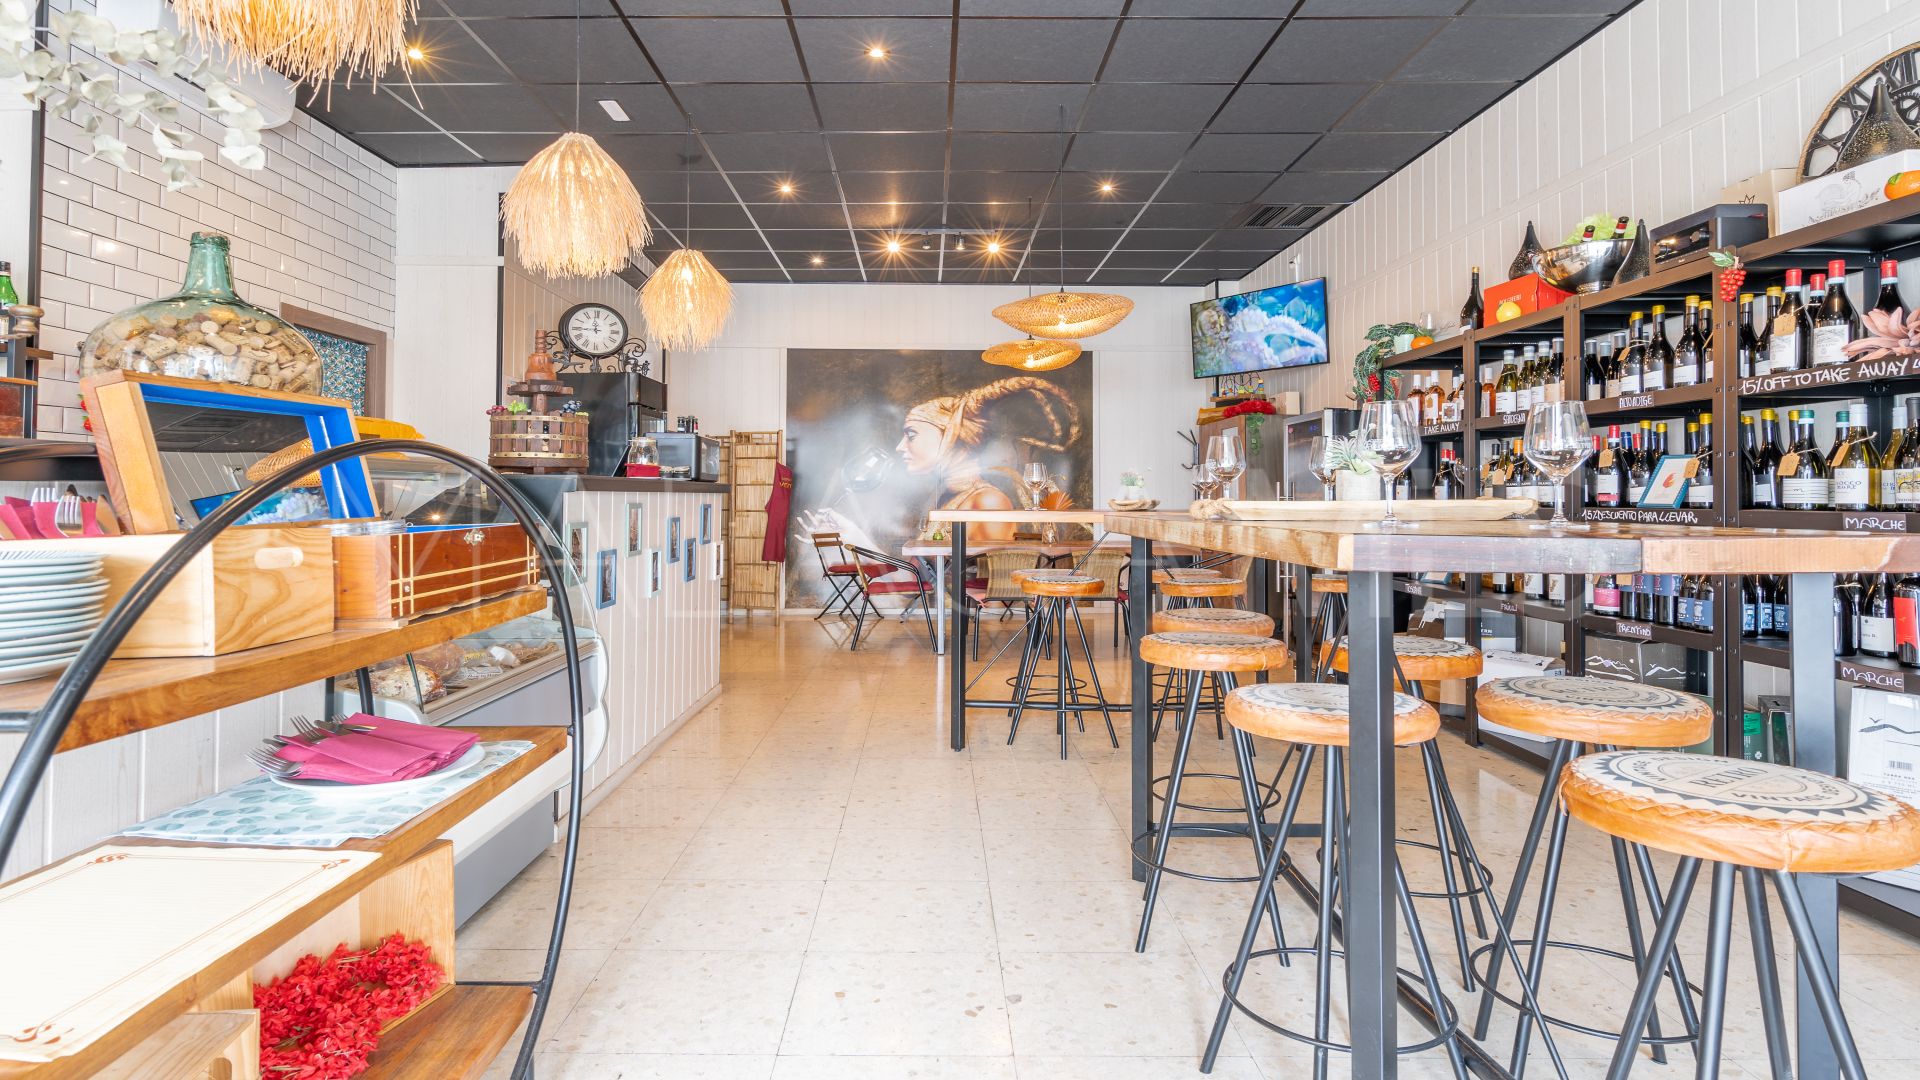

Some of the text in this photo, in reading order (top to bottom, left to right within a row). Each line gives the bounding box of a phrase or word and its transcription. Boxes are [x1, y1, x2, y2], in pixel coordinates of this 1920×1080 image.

[1739, 379, 1763, 395] 15%
[1763, 375, 1792, 391] OFF
[1794, 372, 1812, 387] TO
[1813, 367, 1851, 384] TAKE
[1857, 357, 1909, 378] AWAY
[1423, 422, 1460, 435] TAKE AWAY
[1597, 509, 1637, 521] DESCUENTO
[1637, 510, 1658, 522] PARA
[1659, 510, 1698, 524] LLEVAR
[1844, 516, 1906, 531] MARCHE
[1842, 666, 1904, 688] MARCHE
[1689, 766, 1769, 788] RETRO
[1731, 792, 1832, 802] VINTAGE
